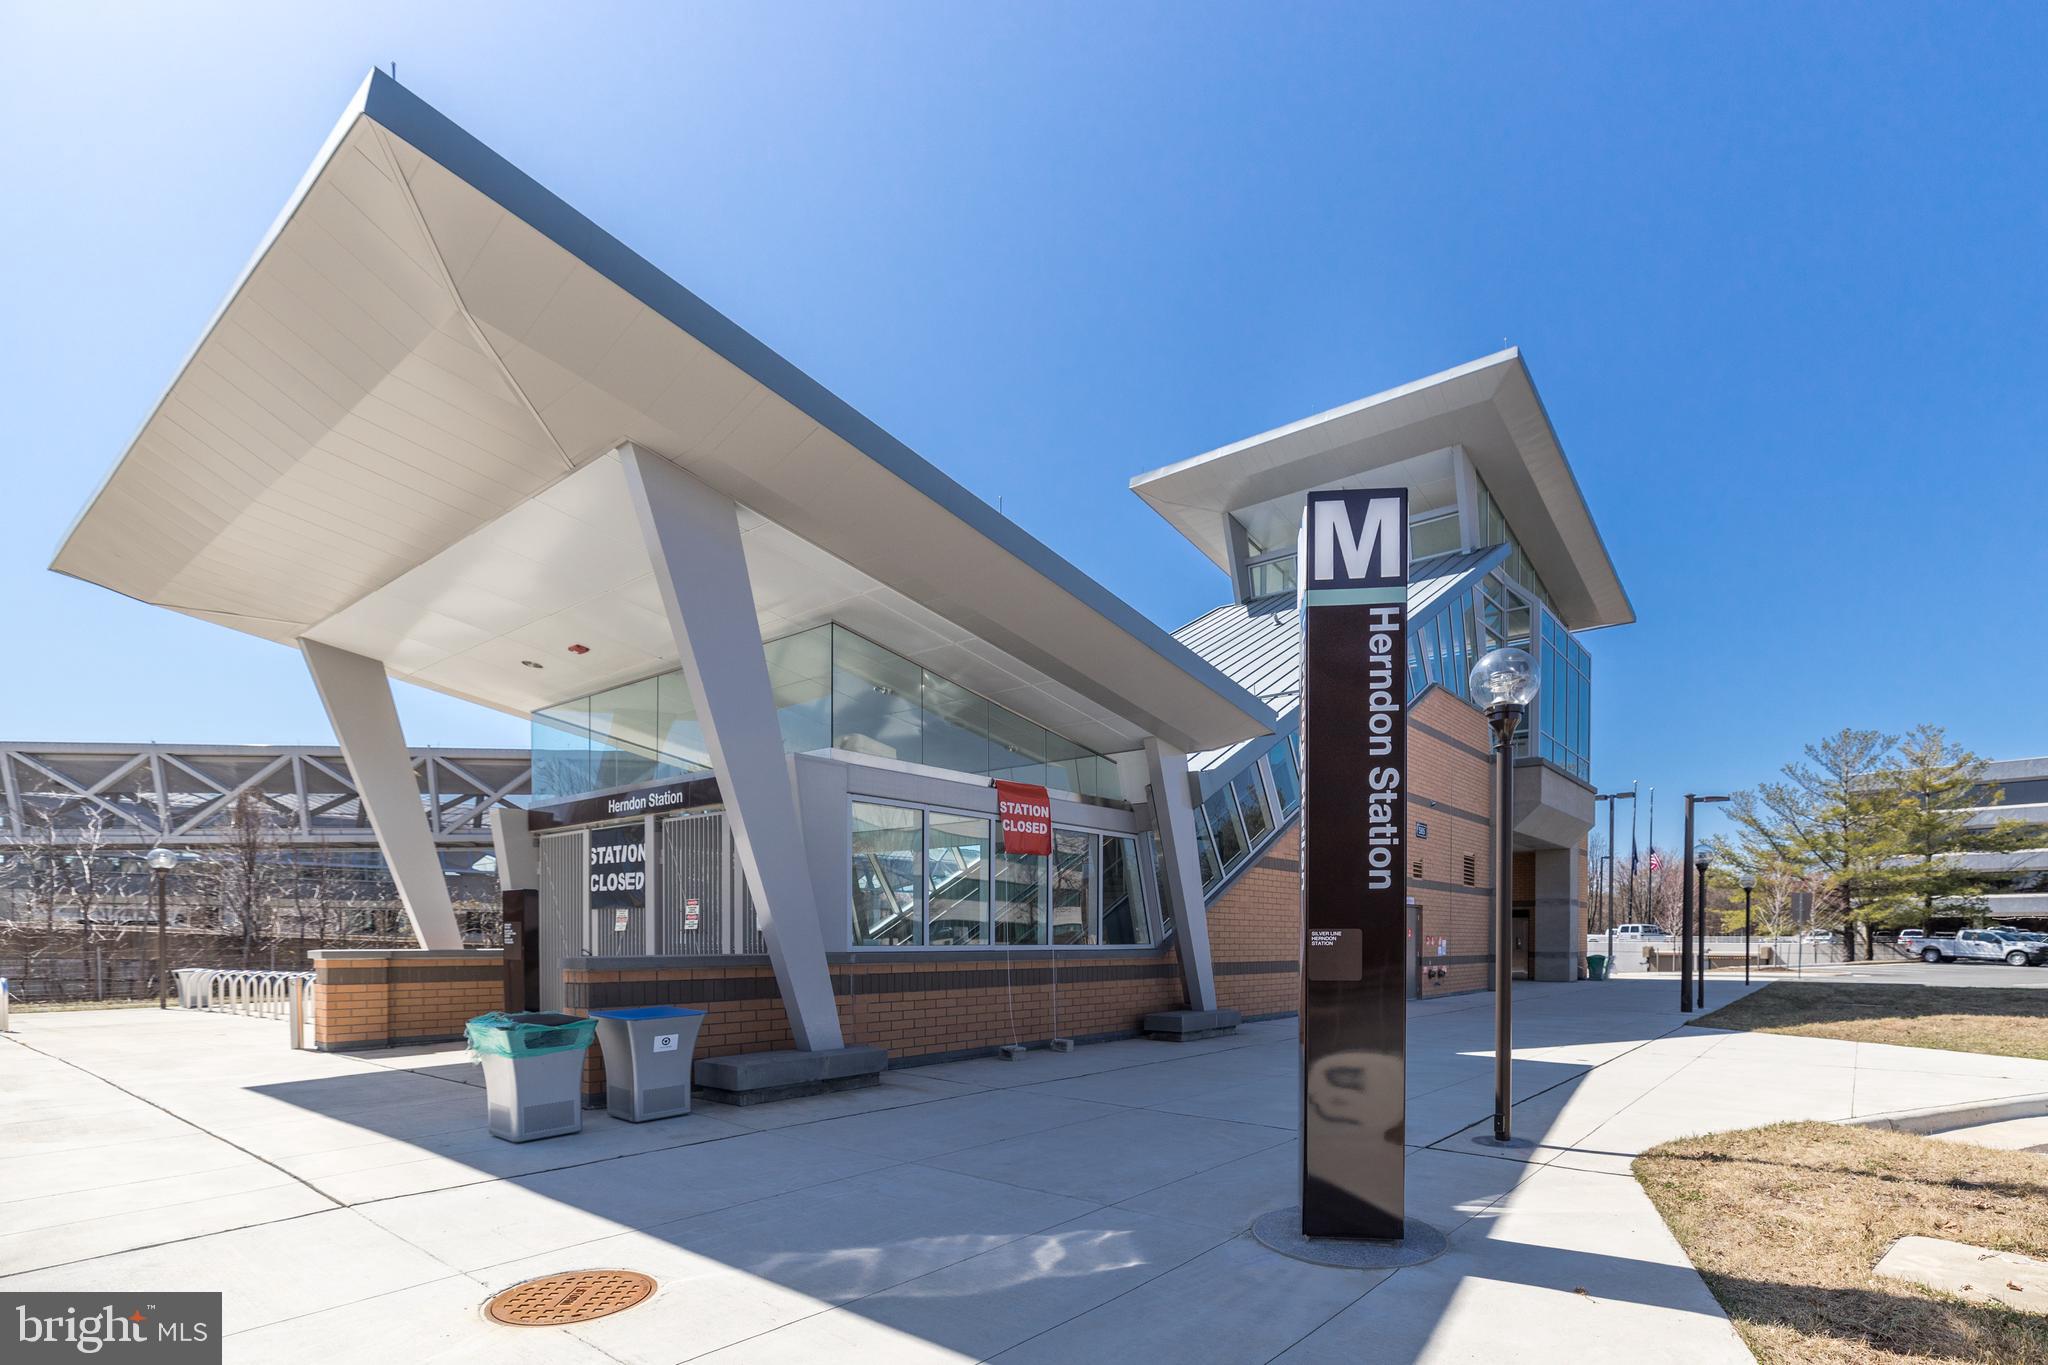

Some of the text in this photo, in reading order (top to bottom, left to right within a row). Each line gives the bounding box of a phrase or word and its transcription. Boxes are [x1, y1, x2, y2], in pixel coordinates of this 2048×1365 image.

[1314, 497, 1401, 581] M
[1368, 606, 1401, 890] Herndon Station
[608, 790, 683, 813] Herndon Station
[1000, 801, 1049, 818] STATION
[1002, 819, 1048, 835] CLOSED
[591, 872, 645, 892] CLOSED
